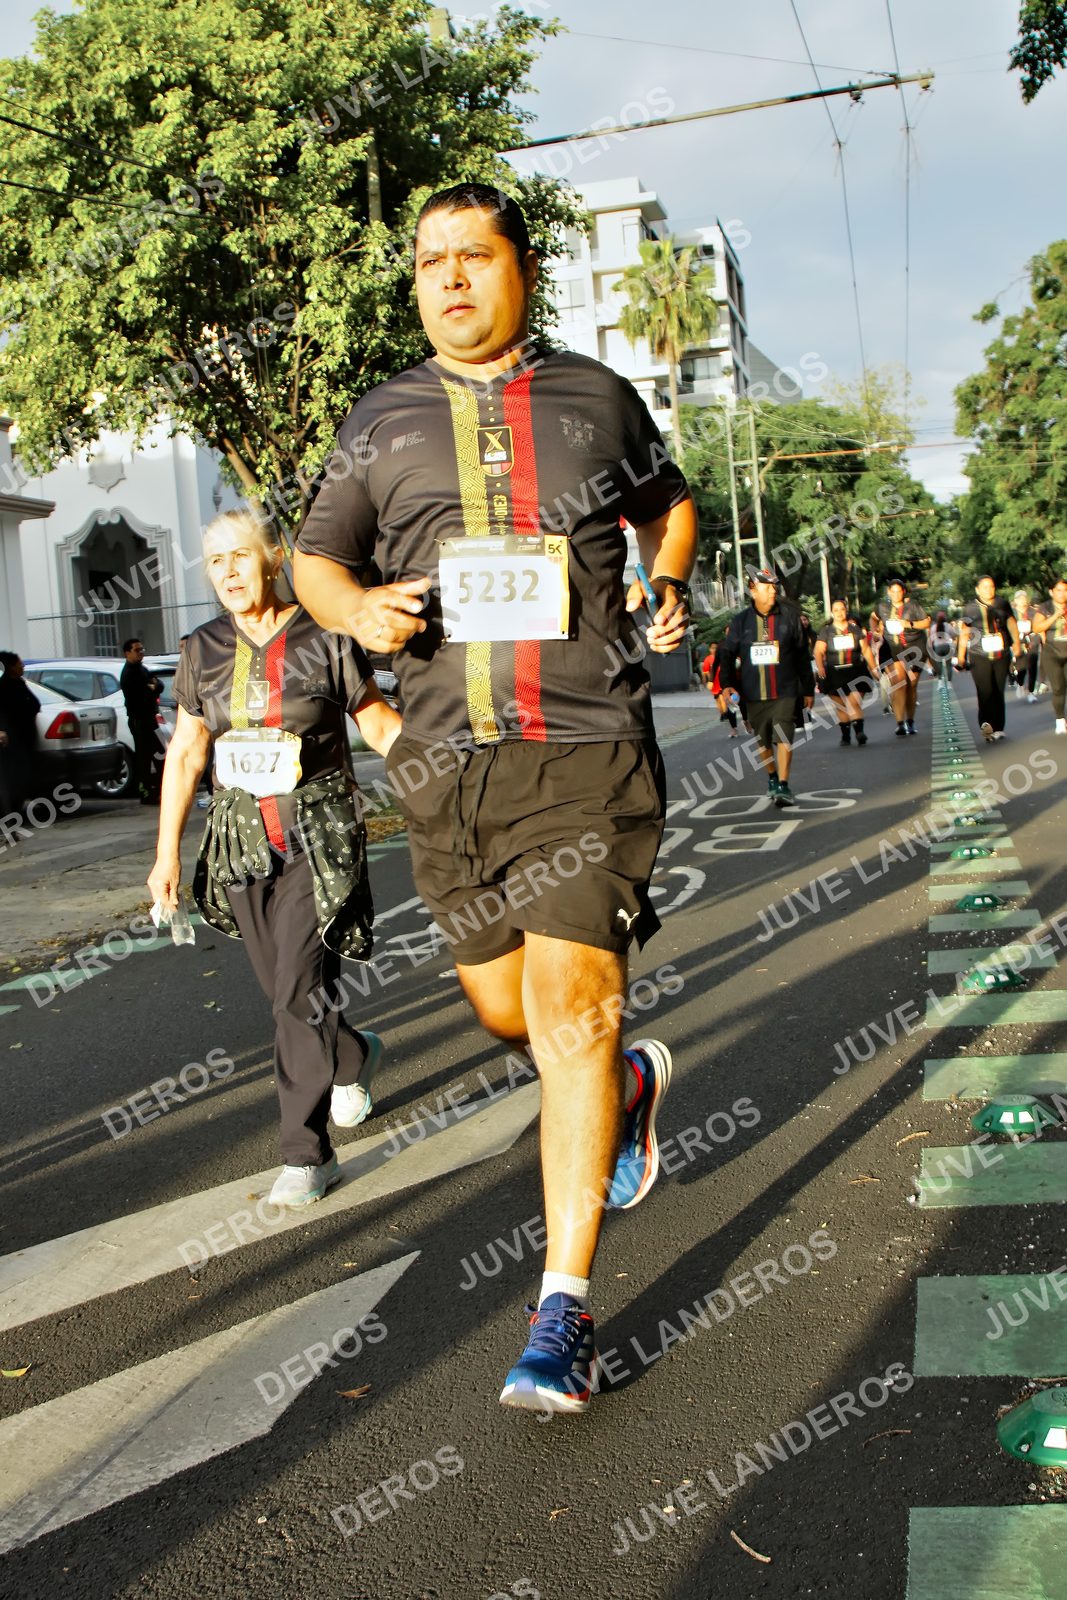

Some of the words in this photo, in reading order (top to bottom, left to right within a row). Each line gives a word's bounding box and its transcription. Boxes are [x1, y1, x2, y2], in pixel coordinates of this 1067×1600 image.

[458, 569, 540, 604] 5232
[754, 648, 773, 656] 3271
[227, 751, 281, 774] 1627
